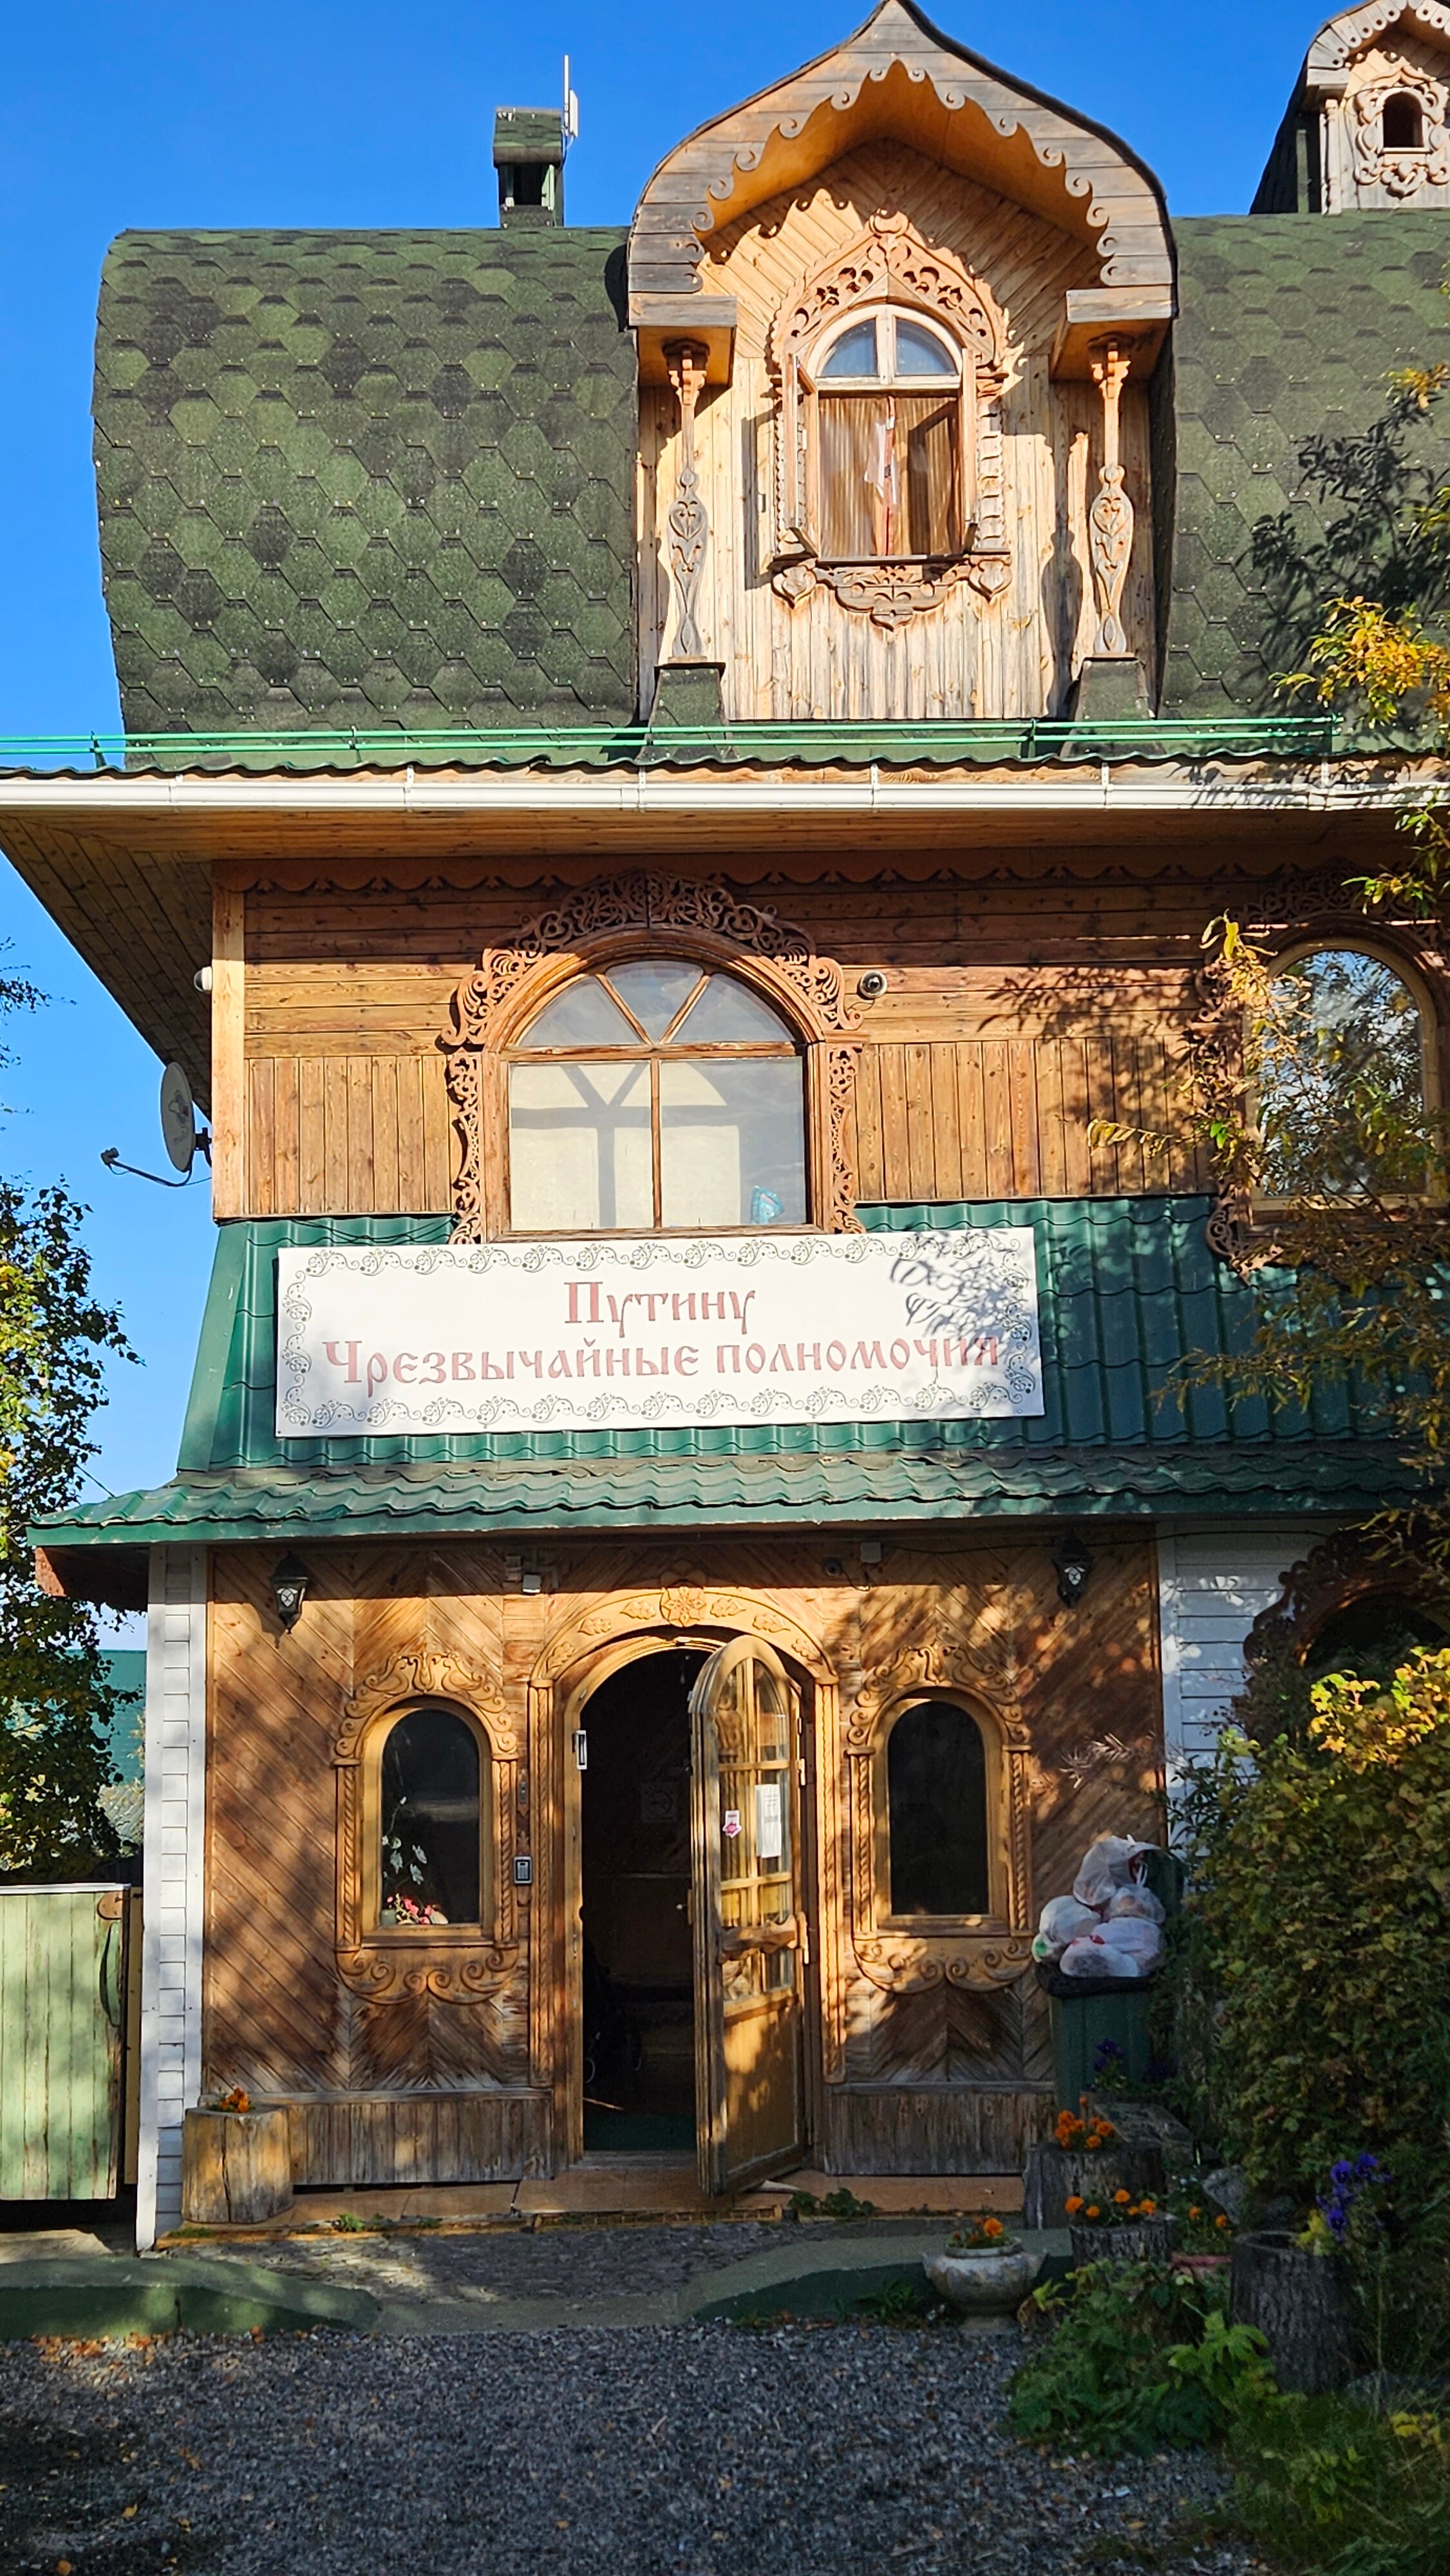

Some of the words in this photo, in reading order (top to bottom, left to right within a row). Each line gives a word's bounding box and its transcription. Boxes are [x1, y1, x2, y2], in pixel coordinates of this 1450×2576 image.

[564, 1282, 755, 1338] Путину
[322, 1338, 699, 1397] Чрезвычайные
[717, 1338, 999, 1374] полномочия
